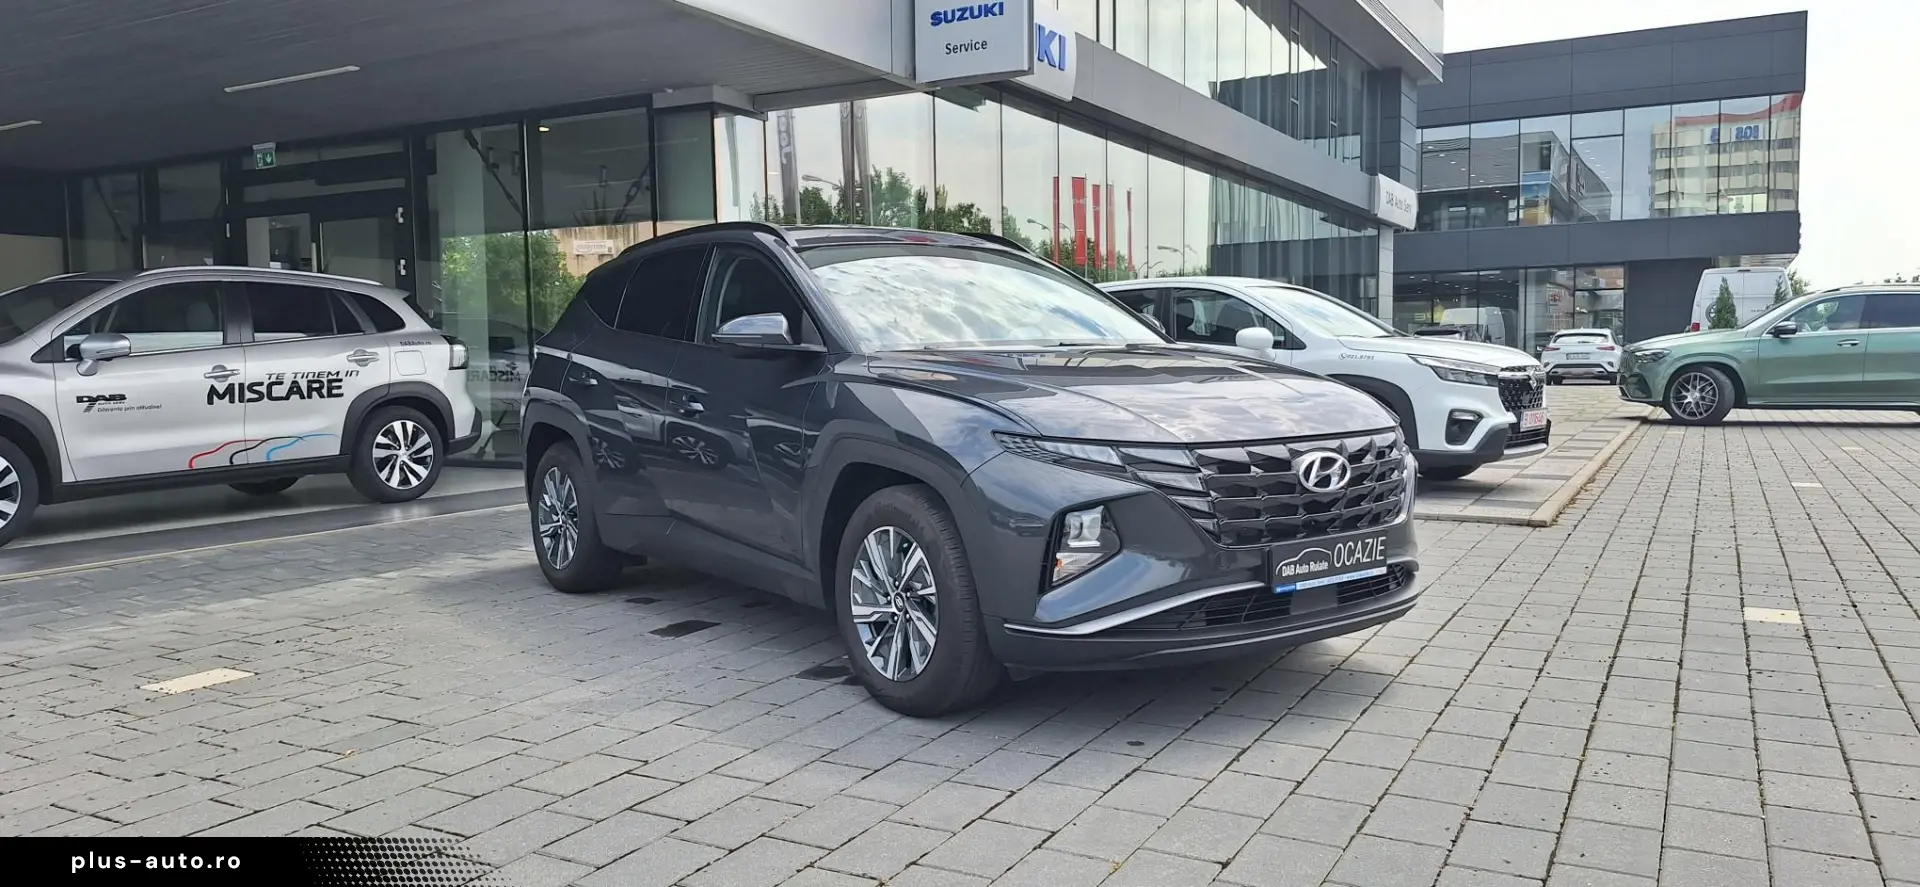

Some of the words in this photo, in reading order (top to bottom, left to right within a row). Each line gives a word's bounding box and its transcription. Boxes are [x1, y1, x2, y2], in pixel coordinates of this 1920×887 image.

[930, 2, 1004, 27] SUZUKI
[945, 39, 988, 55] Service
[1035, 22, 1067, 71] KI
[266, 372, 286, 381] TE
[76, 393, 127, 403] DAB
[206, 378, 344, 406] MISCARE
[1281, 564, 1295, 577] DAB
[1295, 562, 1310, 575] Auto
[1309, 560, 1329, 572] Rulate
[1333, 536, 1387, 568] OCAZIE
